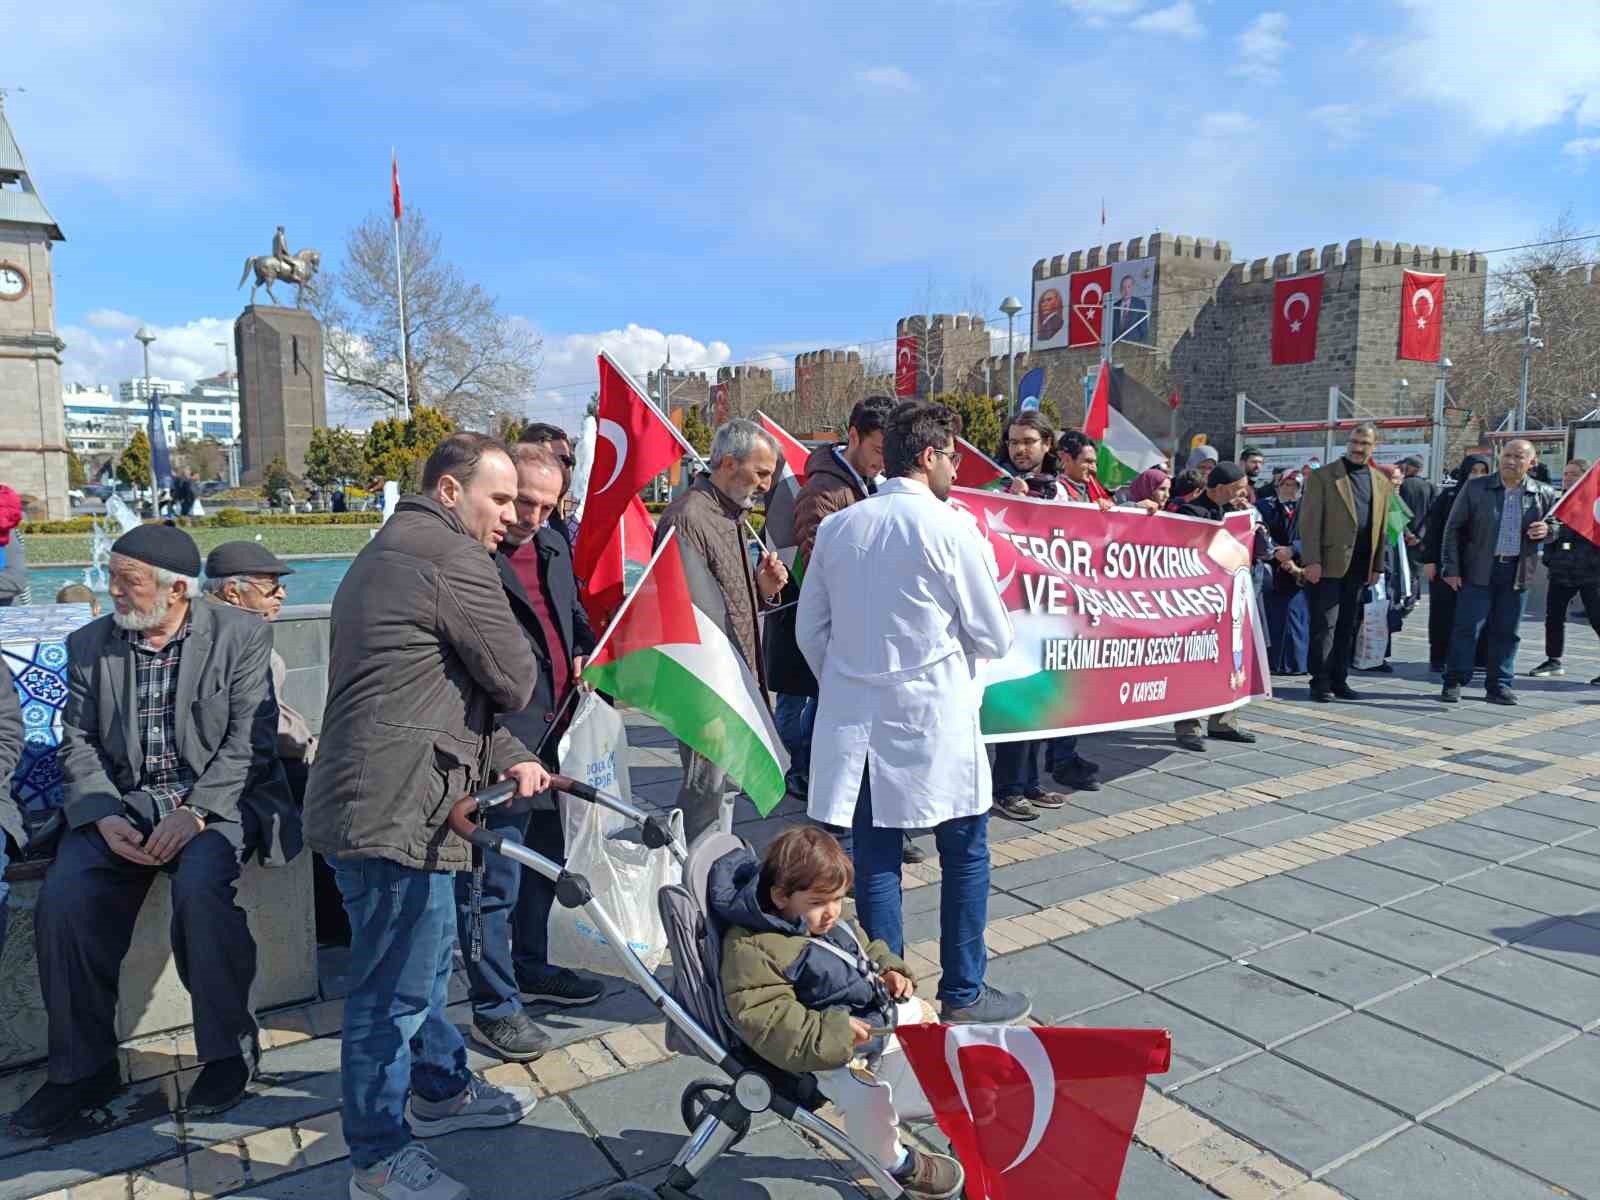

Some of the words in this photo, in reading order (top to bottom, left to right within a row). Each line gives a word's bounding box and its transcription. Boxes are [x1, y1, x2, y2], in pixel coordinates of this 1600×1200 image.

[996, 529, 1099, 584] ERÖR,
[1104, 542, 1211, 578] SOYKIRIM
[1023, 574, 1068, 615] VE
[1151, 584, 1228, 623] KARŞI
[1045, 635, 1145, 671] HEKİMLERDEN
[1145, 632, 1183, 665] SESSİZ
[1132, 677, 1168, 703] KAYSERİ
